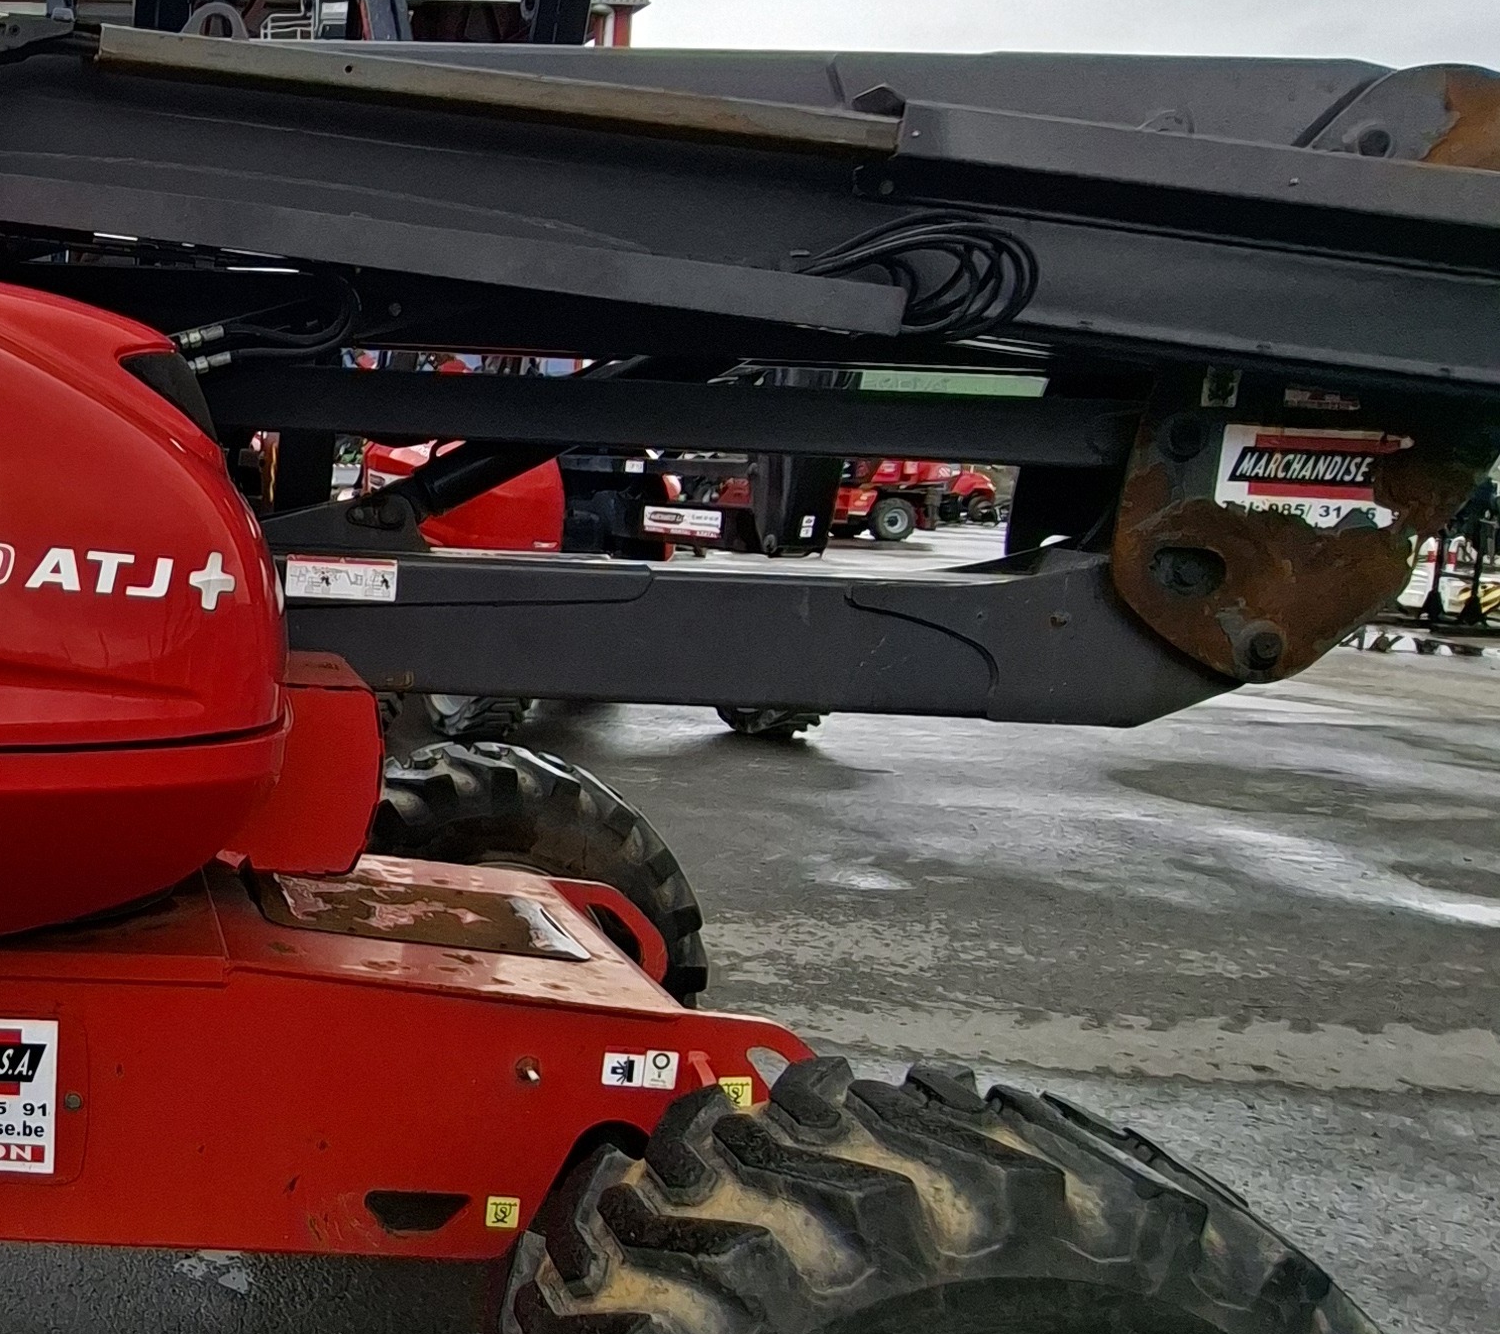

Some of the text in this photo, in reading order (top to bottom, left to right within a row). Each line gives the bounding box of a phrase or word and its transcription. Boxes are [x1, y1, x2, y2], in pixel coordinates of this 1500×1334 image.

[1236, 453, 1375, 481] MARCHANDISE
[1318, 505, 1342, 518] 31
[22, 1103, 48, 1116] 91
